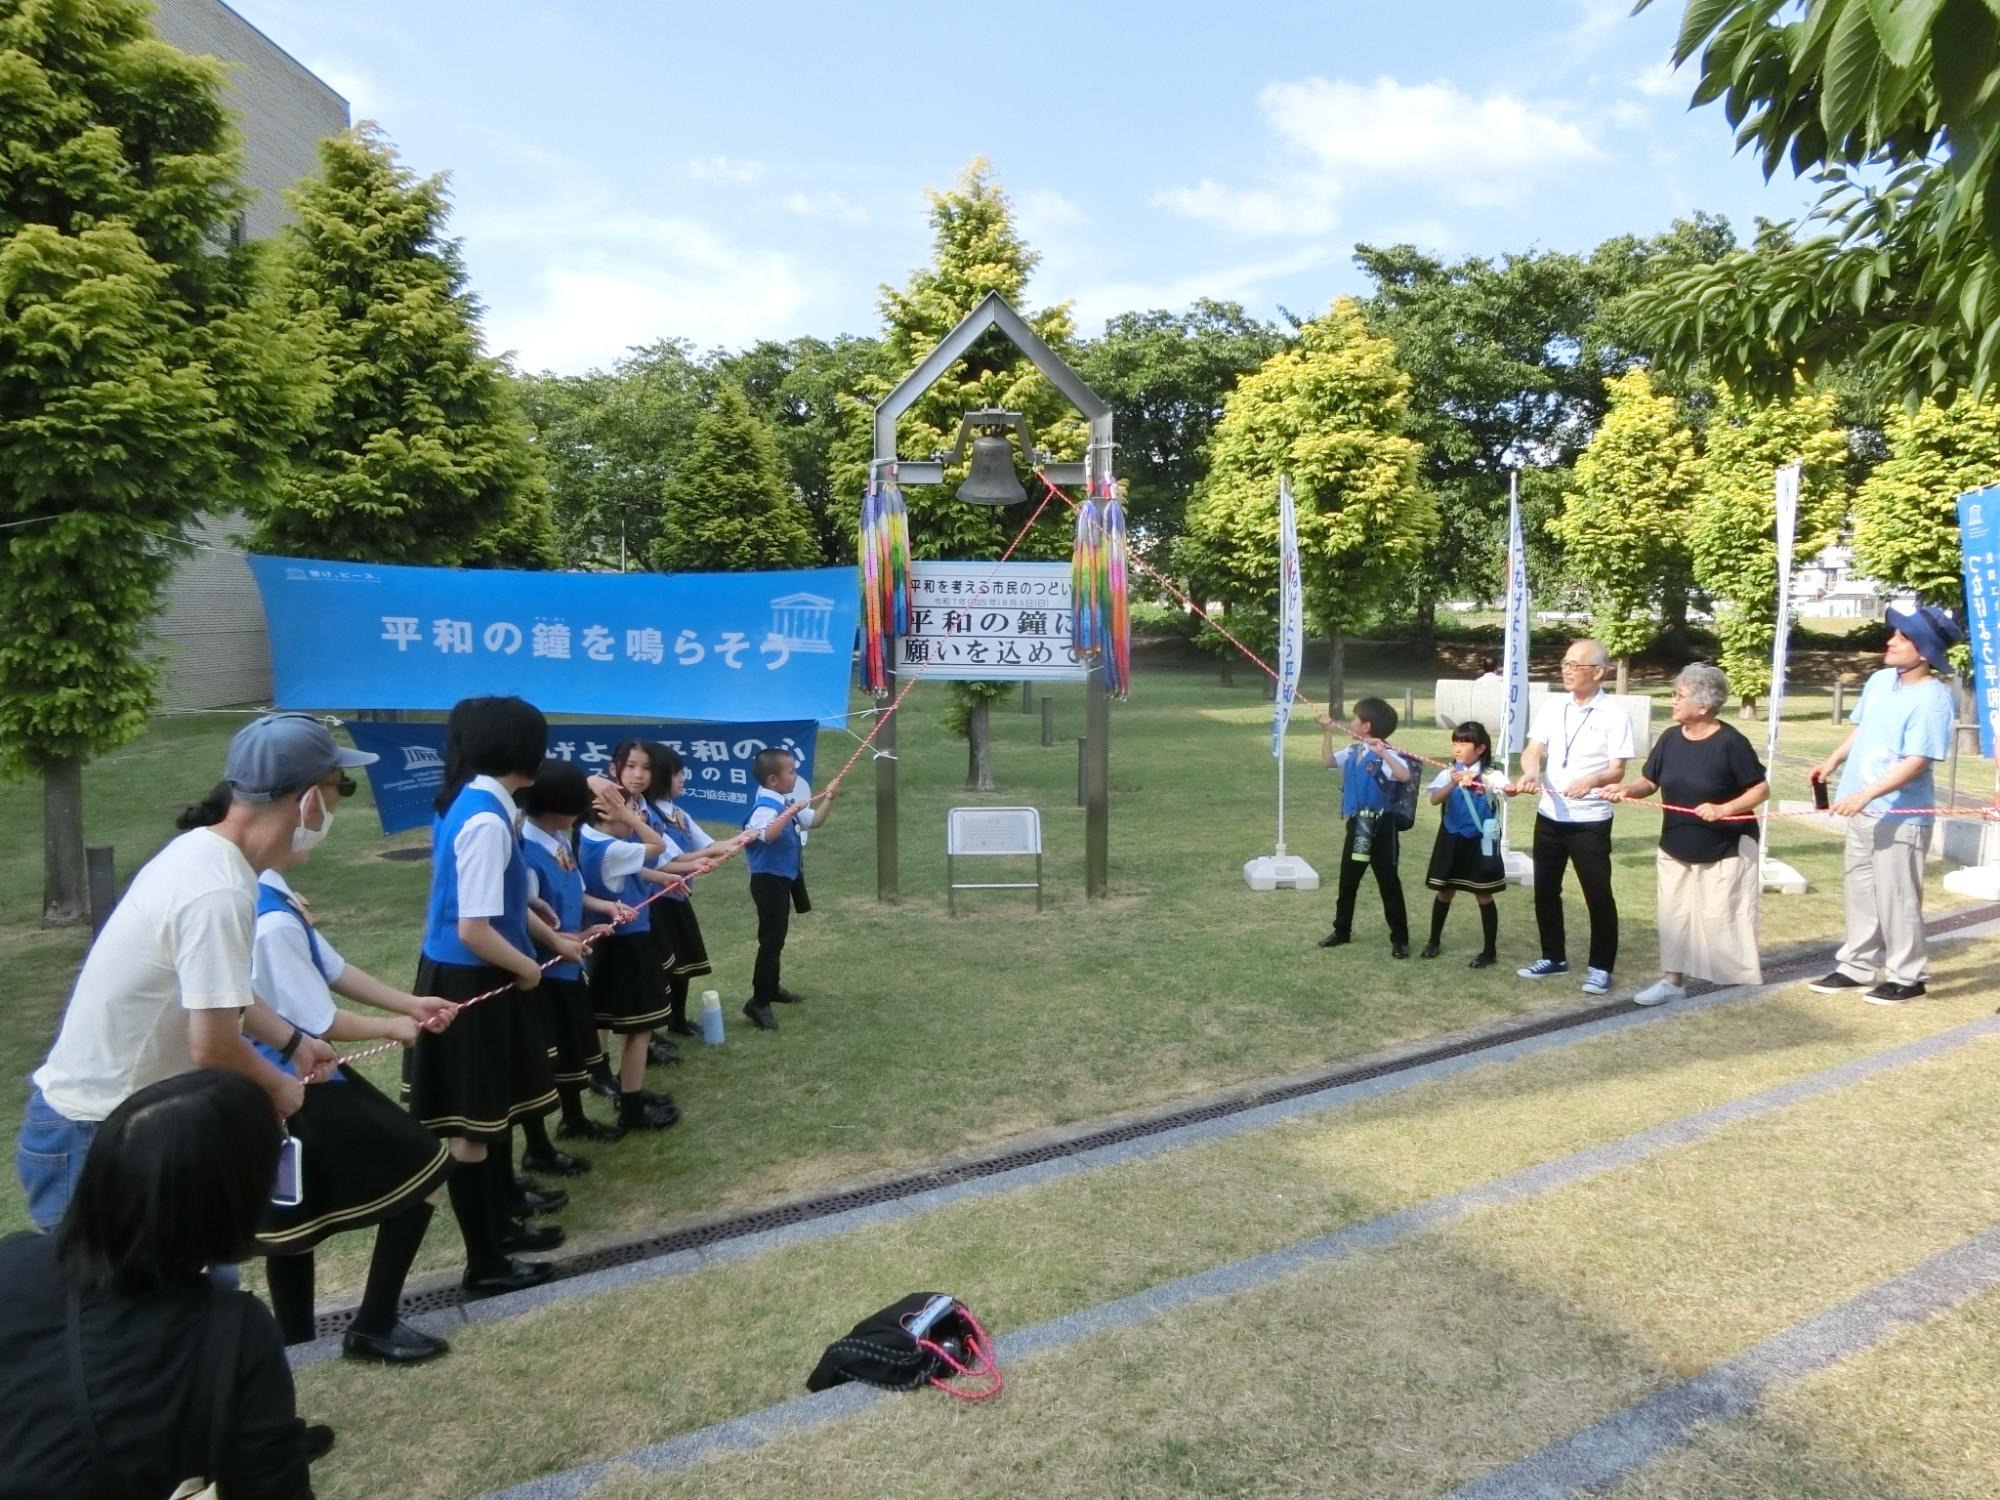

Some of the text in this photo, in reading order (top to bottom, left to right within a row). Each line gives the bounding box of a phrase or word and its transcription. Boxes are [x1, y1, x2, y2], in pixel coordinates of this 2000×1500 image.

[911, 579, 1072, 596] 平和を考える市民のつどい
[911, 609, 1072, 635] 平和の鐘に
[381, 616, 790, 671] 平和の鐘を鳴らそう
[905, 638, 1080, 664] 願いを込めて
